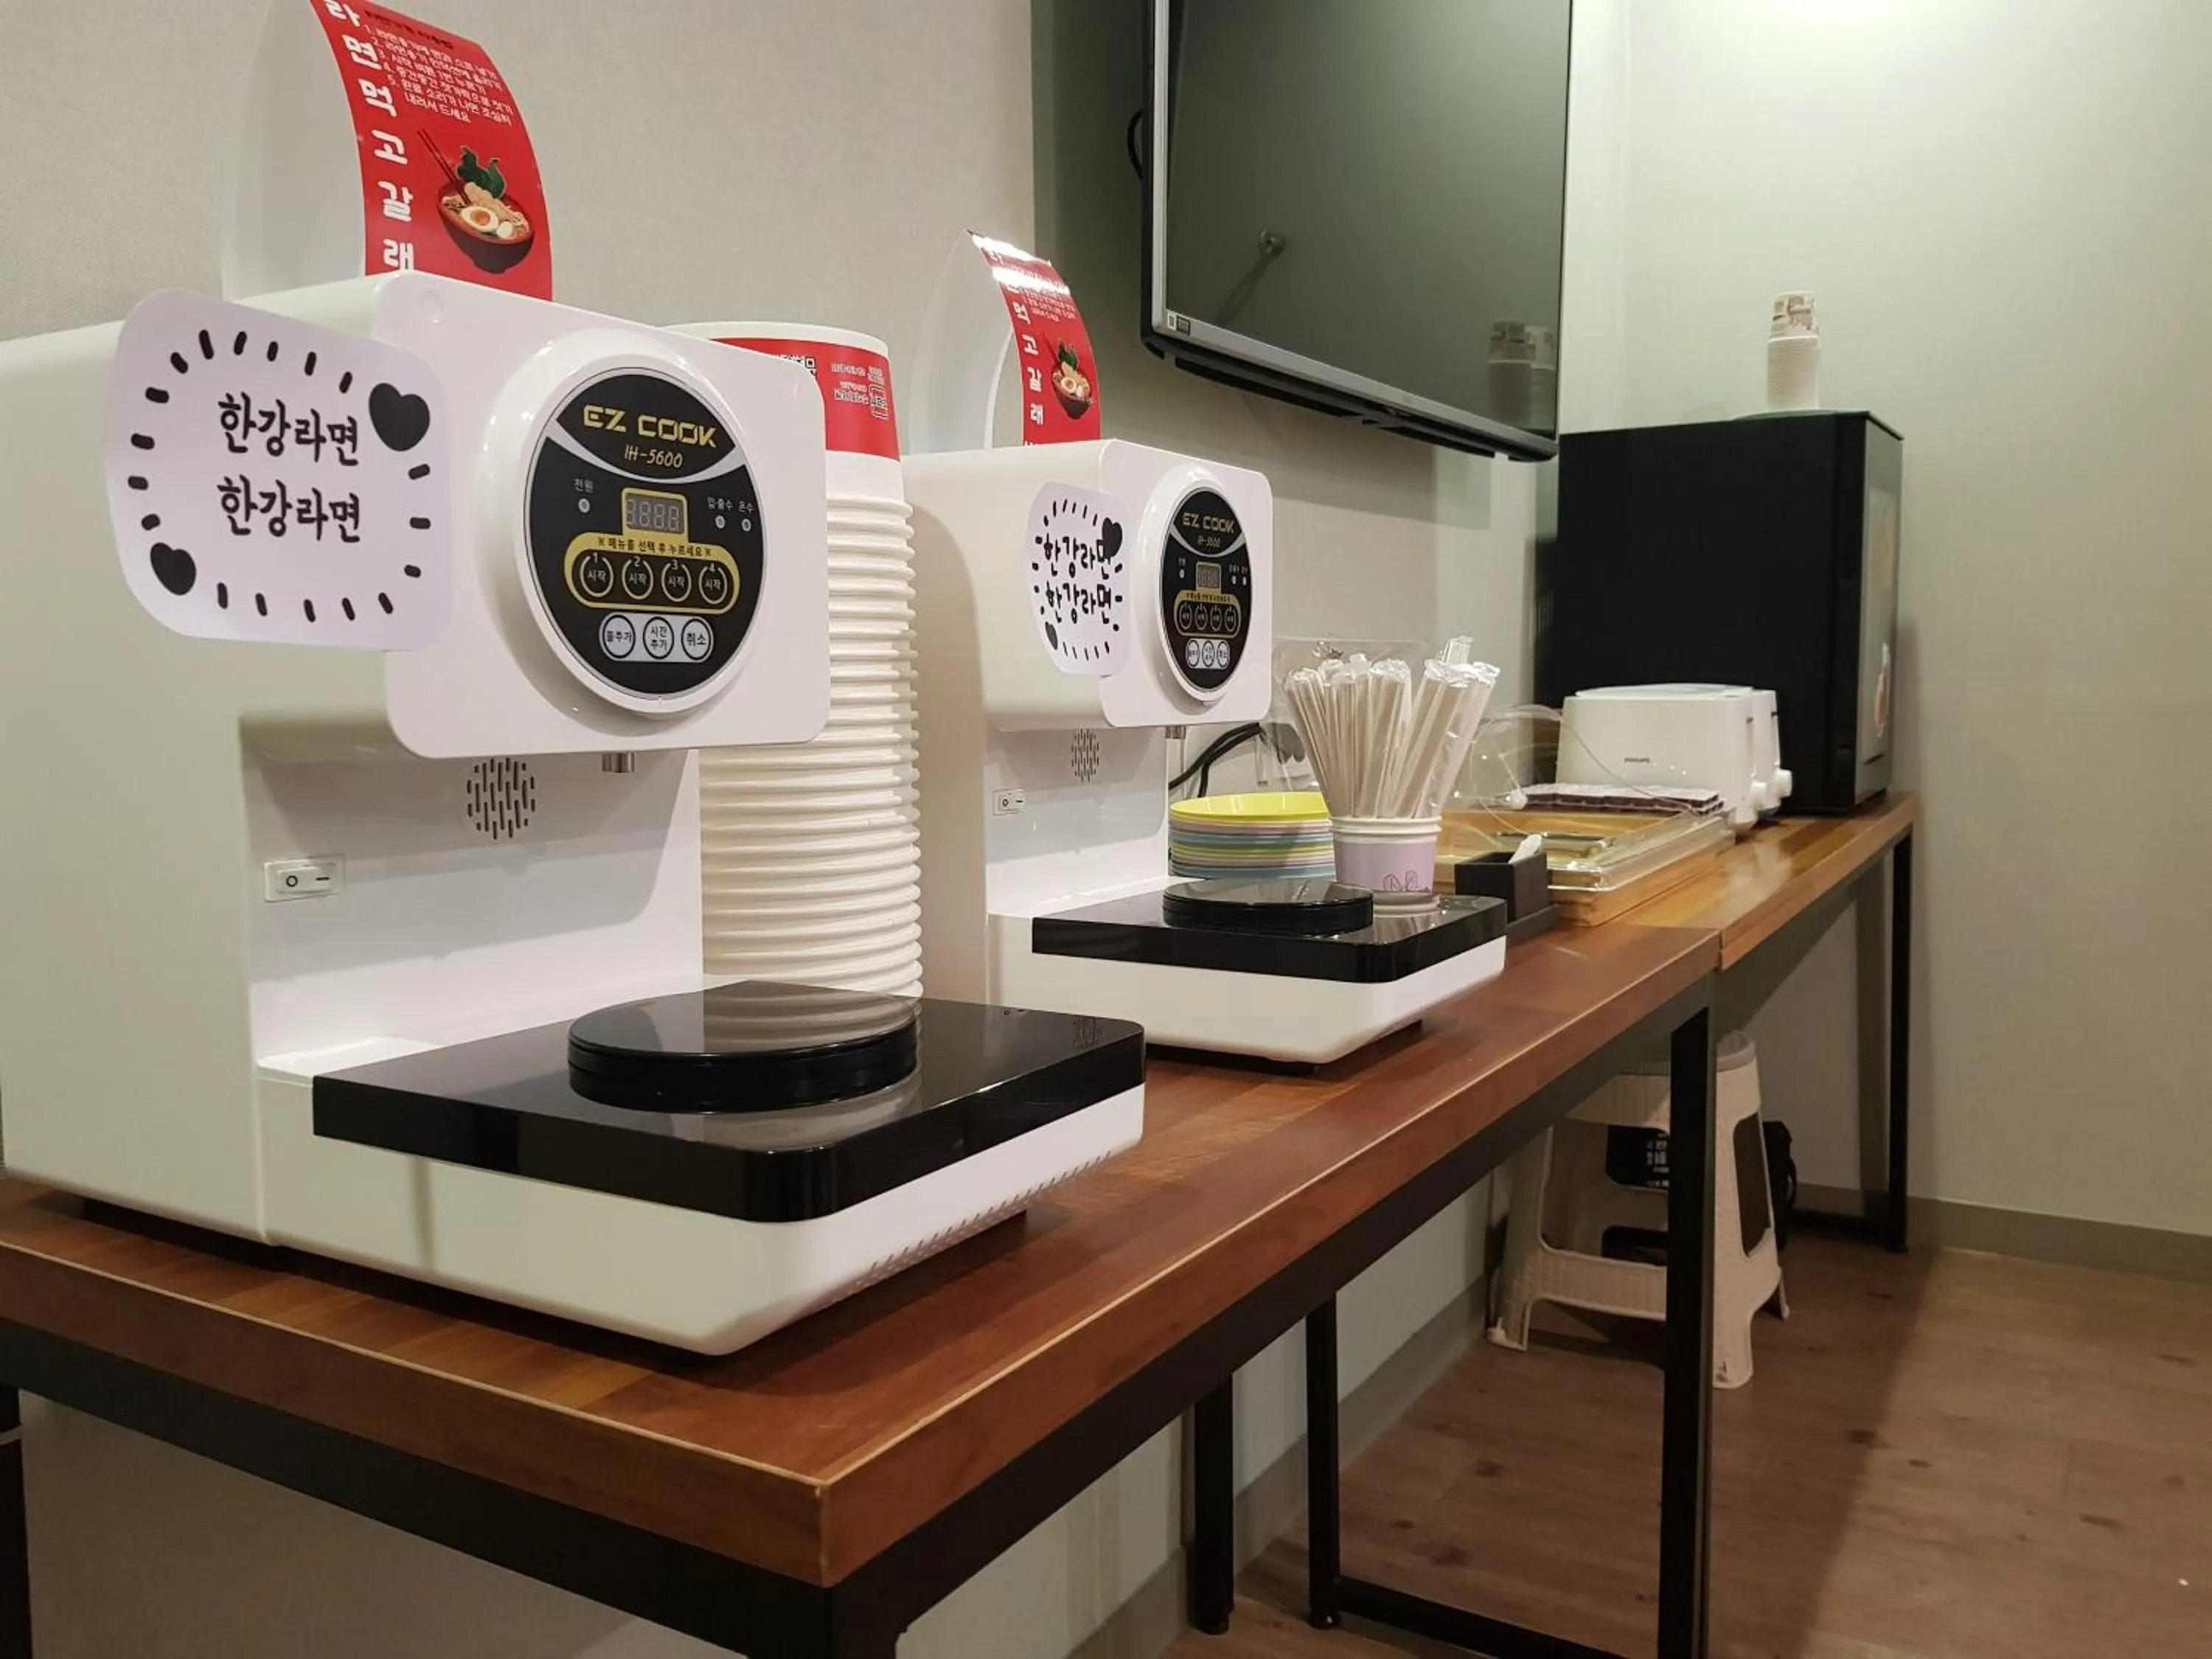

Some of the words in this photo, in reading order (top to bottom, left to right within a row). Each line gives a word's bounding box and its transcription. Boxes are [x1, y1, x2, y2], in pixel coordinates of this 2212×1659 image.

[218, 392, 358, 466] 한강라면
[583, 404, 627, 434] EZ
[638, 414, 717, 448] COOK
[625, 444, 684, 469] IH-5600
[217, 474, 361, 543] 한강라면
[1183, 512, 1200, 528] EZ
[1203, 516, 1234, 534] COOK
[639, 540, 655, 553] 선택
[669, 544, 703, 557] 누르세요
[593, 552, 599, 563] 1
[634, 555, 641, 567] 2
[672, 559, 679, 571] 3
[709, 562, 715, 573] 4
[588, 570, 606, 582] 시작
[629, 572, 647, 586] 시작
[668, 575, 685, 589] 시작
[705, 578, 722, 591] 시작
[1046, 581, 1111, 625] 한강라면
[650, 626, 667, 638] 시간
[651, 639, 667, 652] 추가
[686, 633, 706, 647] 취소
